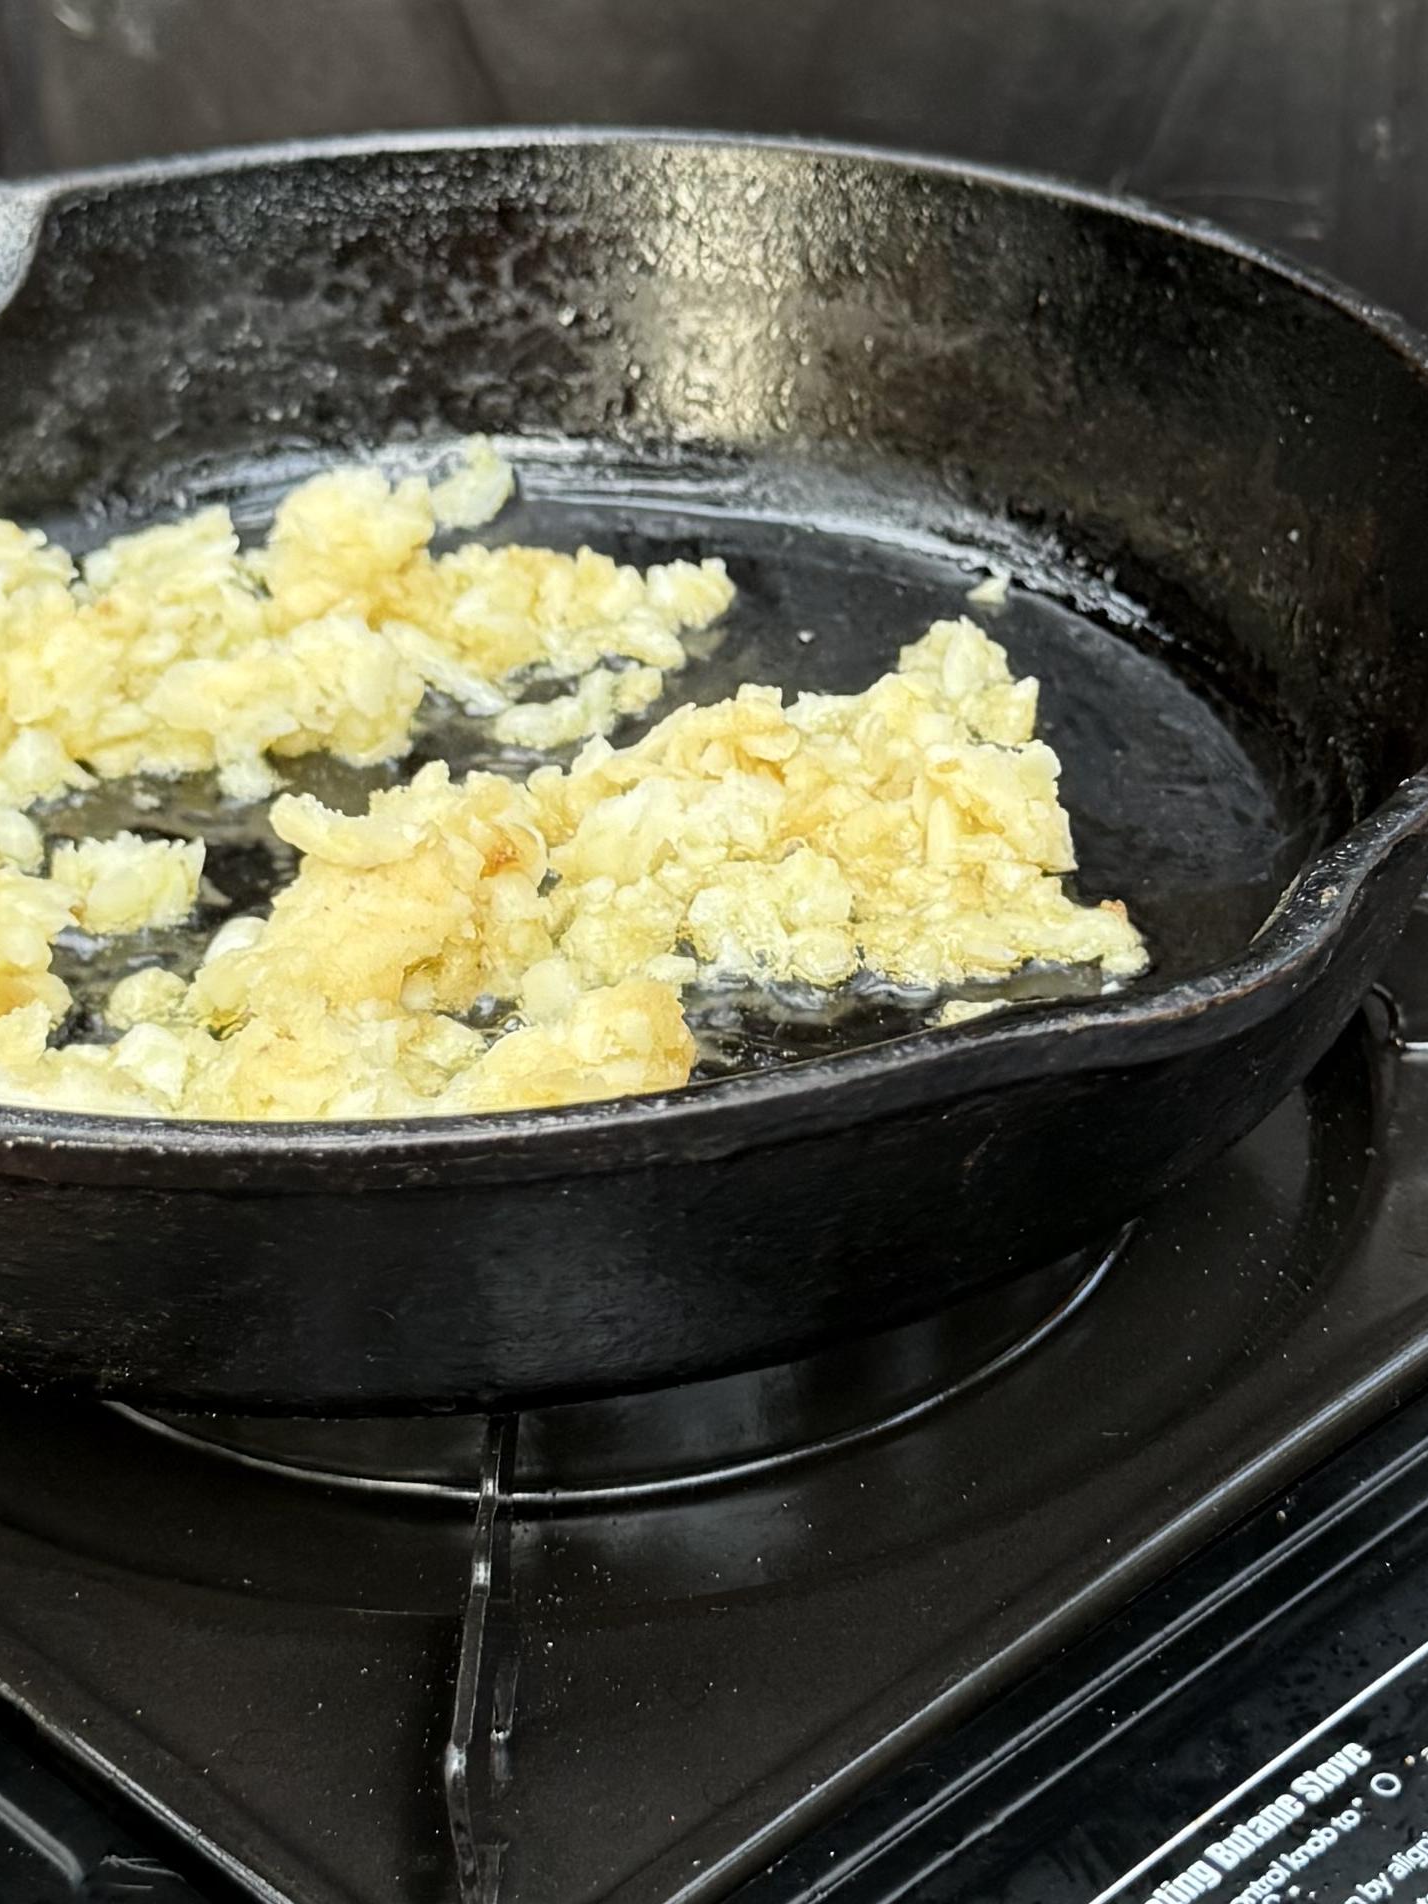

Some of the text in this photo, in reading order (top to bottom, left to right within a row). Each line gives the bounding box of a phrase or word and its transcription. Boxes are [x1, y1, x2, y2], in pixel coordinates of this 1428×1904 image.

[1203, 1793, 1306, 1871] Butane
[1290, 1742, 1372, 1803] Stove
[1279, 1826, 1339, 1871] knob
[1355, 1872, 1394, 1902] by
